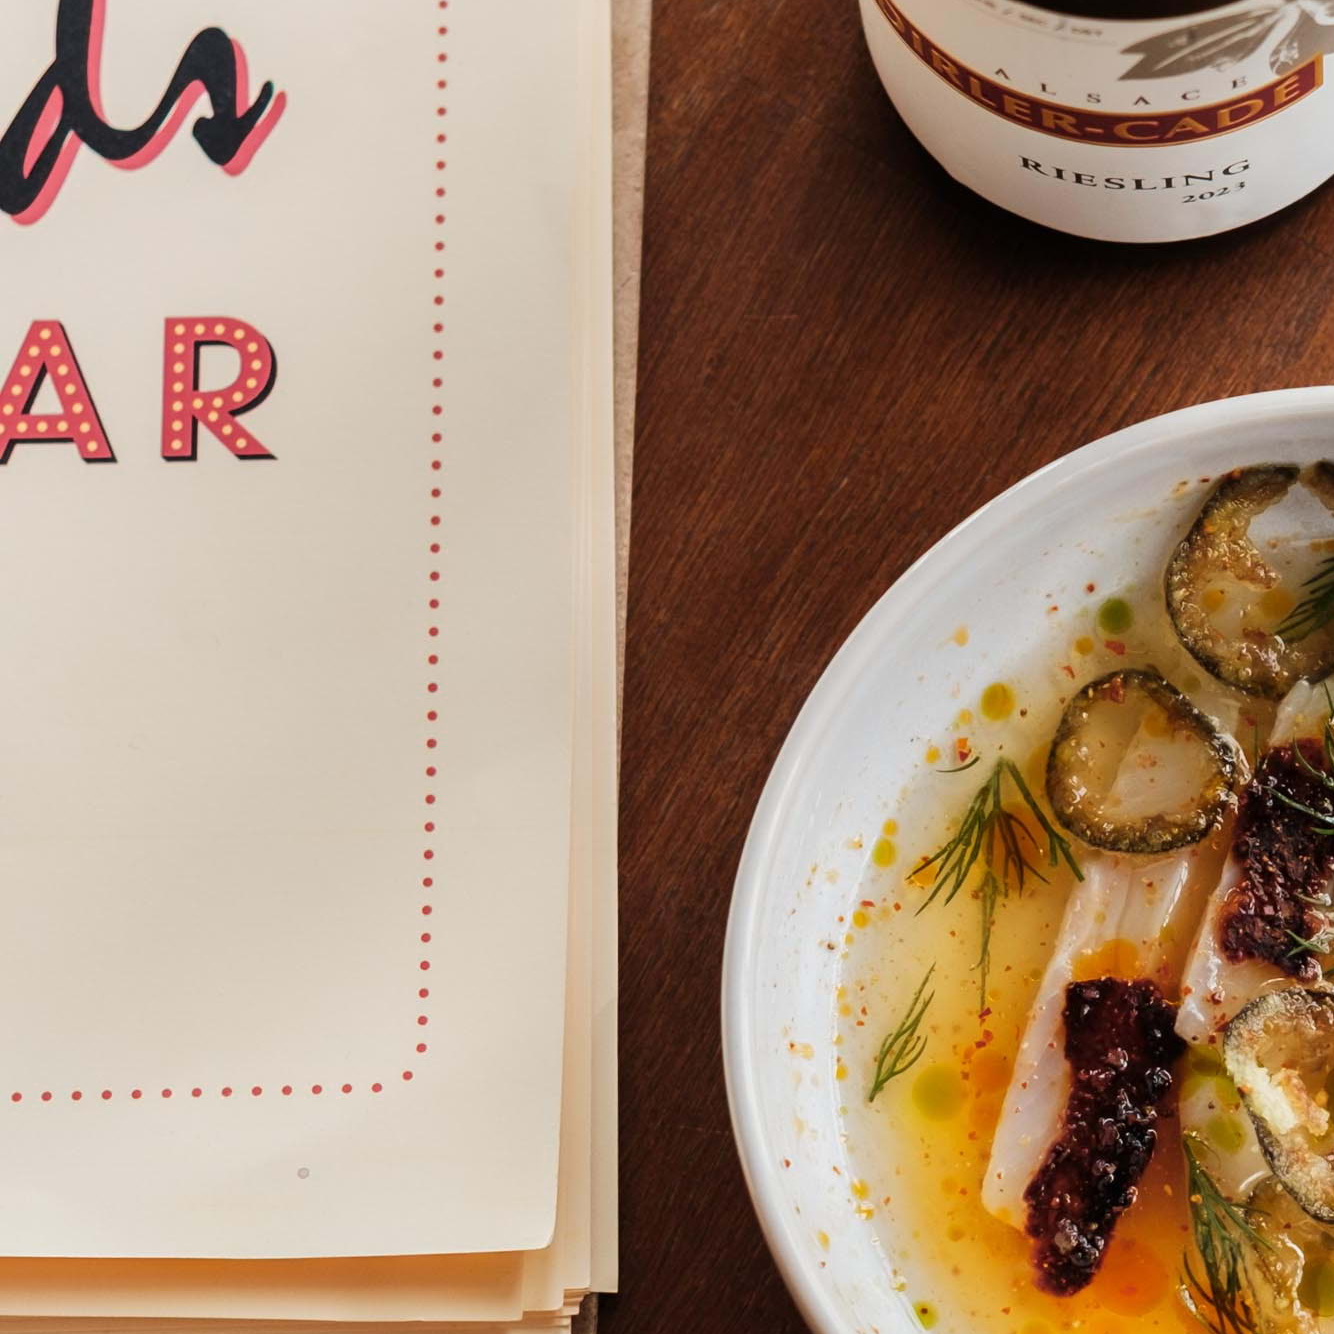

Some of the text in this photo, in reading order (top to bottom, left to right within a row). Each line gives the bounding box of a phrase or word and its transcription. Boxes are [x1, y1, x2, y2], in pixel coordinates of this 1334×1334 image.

[995, 68, 1247, 106] ALSACE
[1019, 155, 1251, 191] RIESLING
[1181, 181, 1246, 204] 2023
